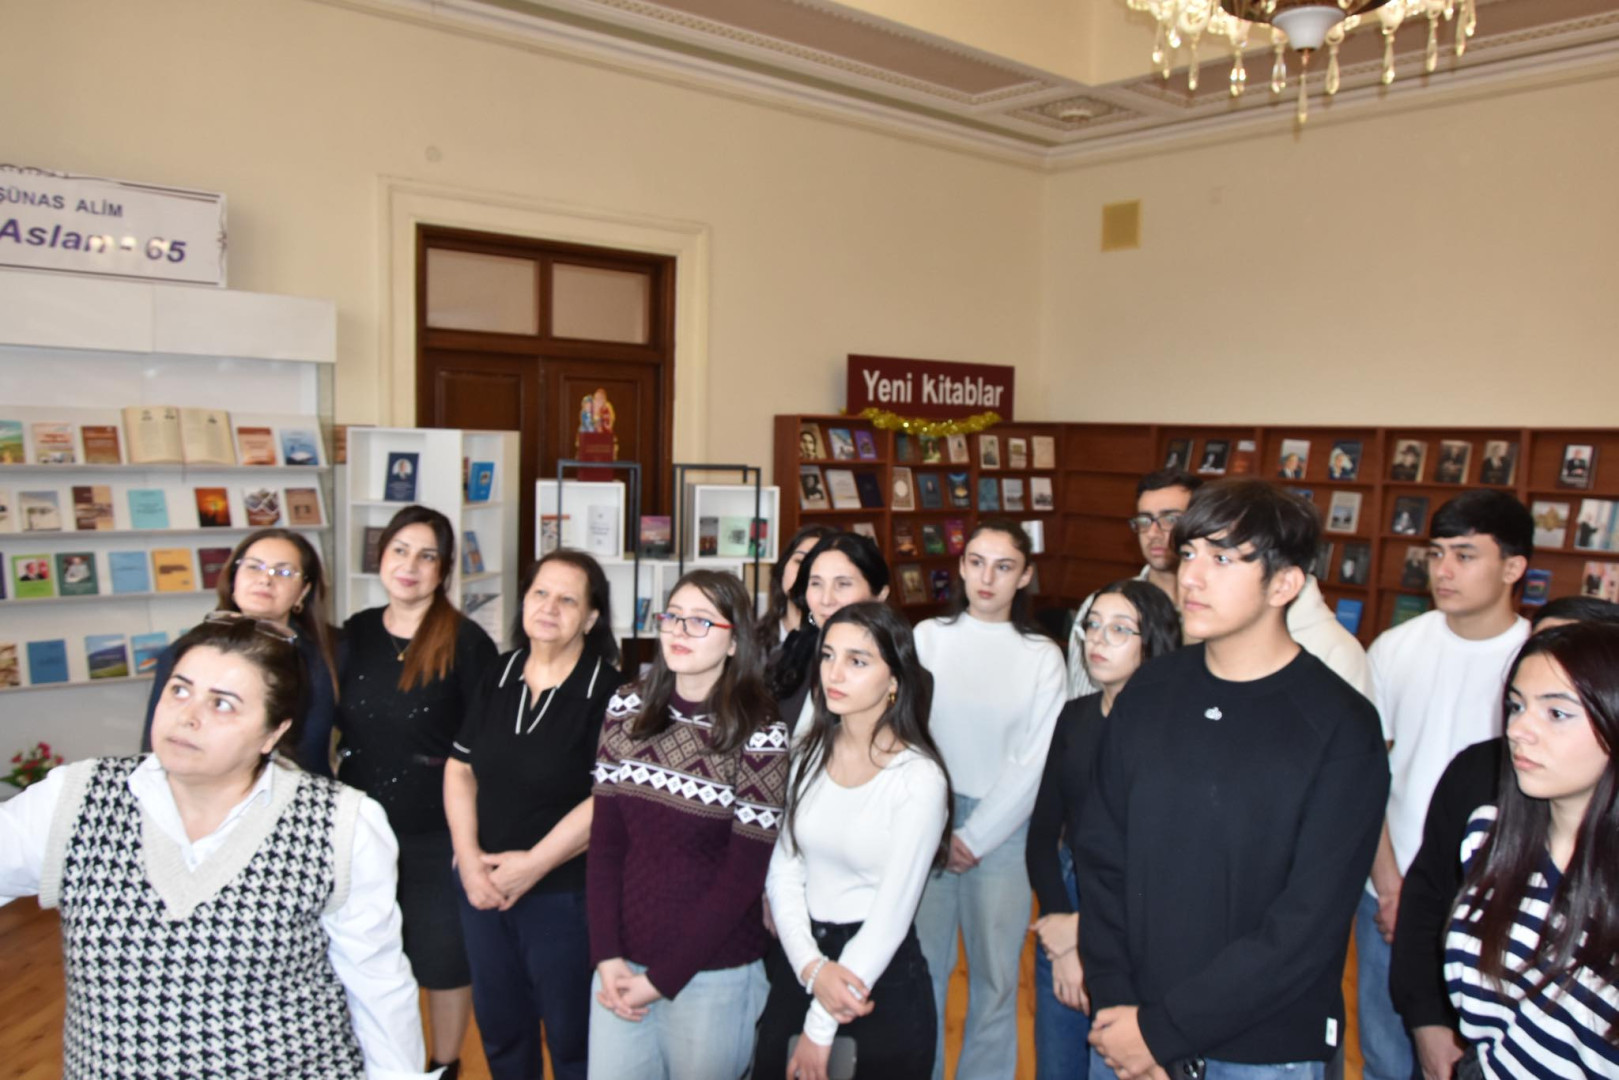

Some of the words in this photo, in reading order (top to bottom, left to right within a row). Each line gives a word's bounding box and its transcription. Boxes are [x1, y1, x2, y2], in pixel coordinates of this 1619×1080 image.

[75, 198, 123, 218] ALİM
[0, 218, 107, 254] Aslan
[145, 236, 187, 263] 65
[862, 369, 913, 403] Yeni
[922, 373, 1004, 408] Kitablar
